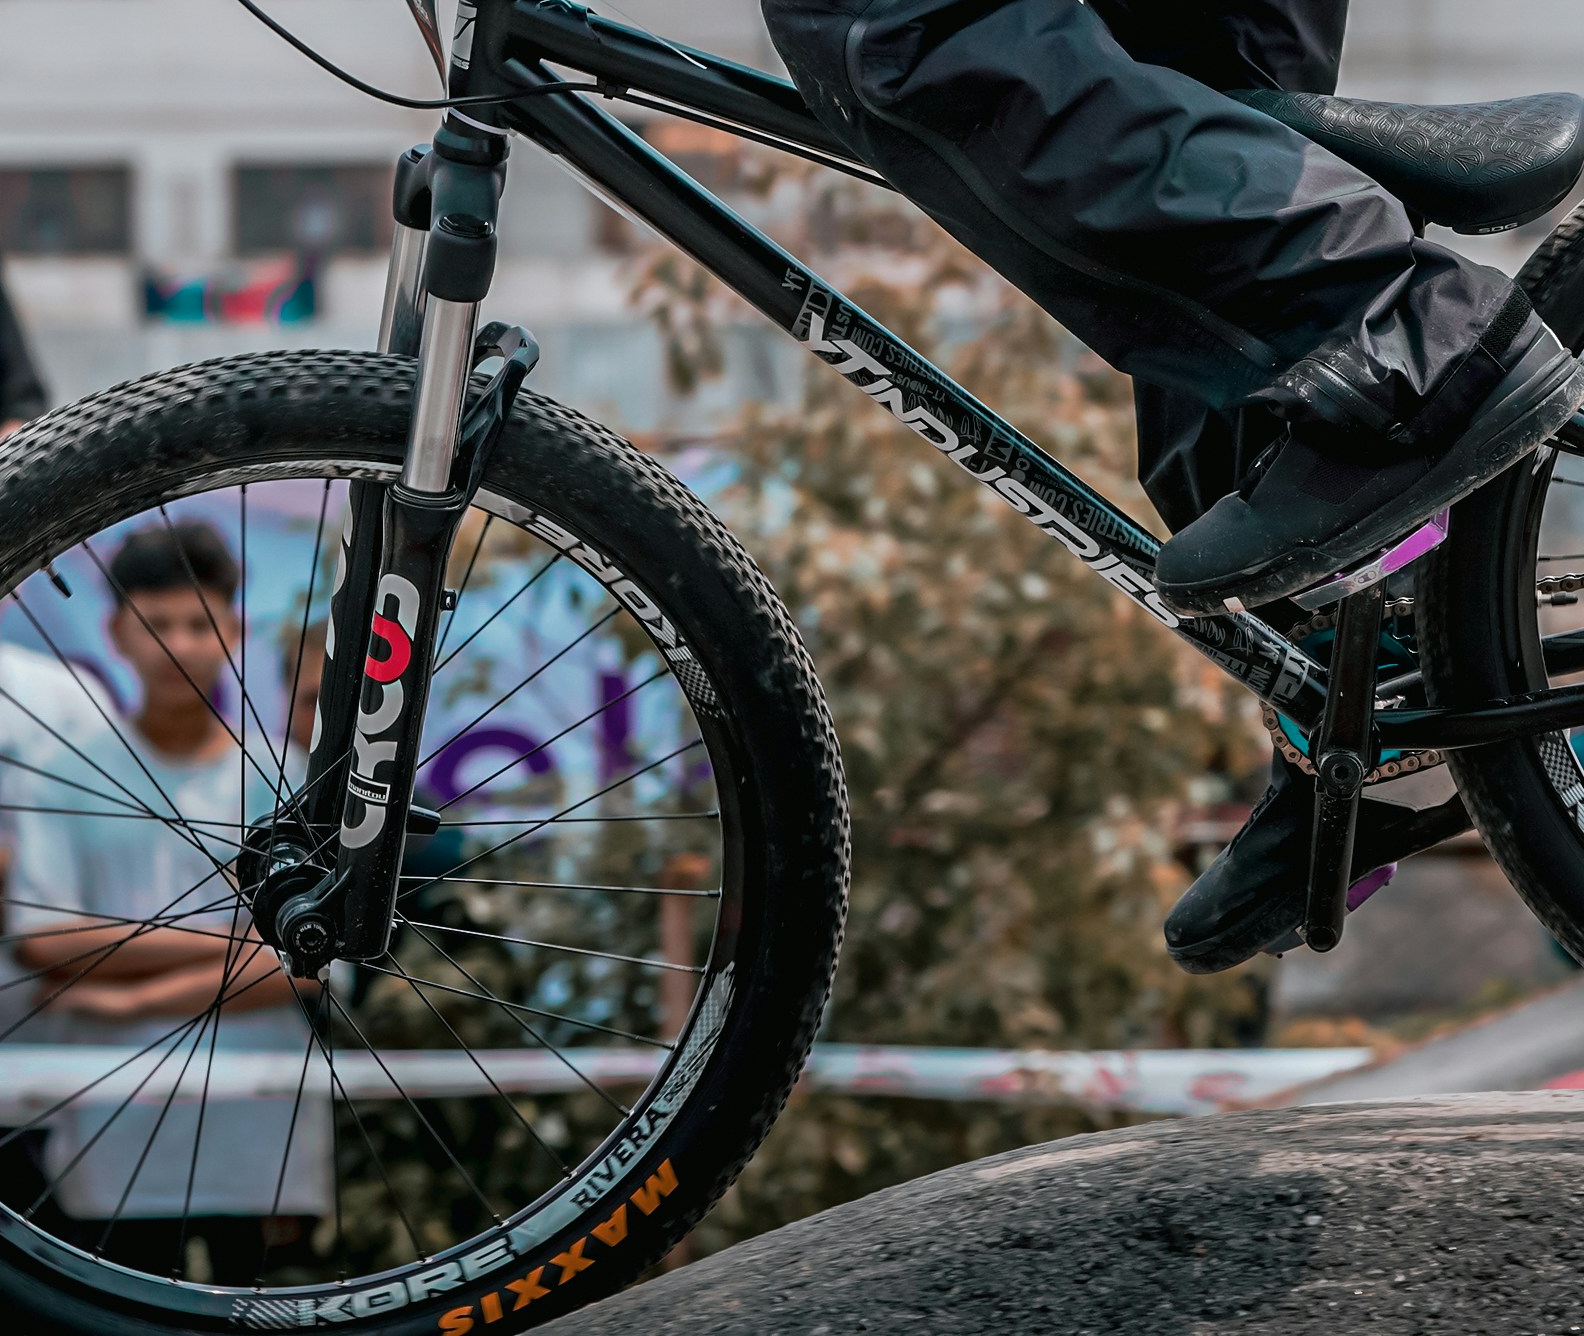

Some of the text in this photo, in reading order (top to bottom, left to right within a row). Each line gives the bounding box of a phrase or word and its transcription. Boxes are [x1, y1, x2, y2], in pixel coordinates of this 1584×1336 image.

[526, 514, 692, 662] KORE
[346, 782, 387, 802] manitou
[570, 1106, 672, 1210] RIVERA
[297, 1236, 516, 1328] KORE
[438, 1157, 680, 1336] MAXXIS
